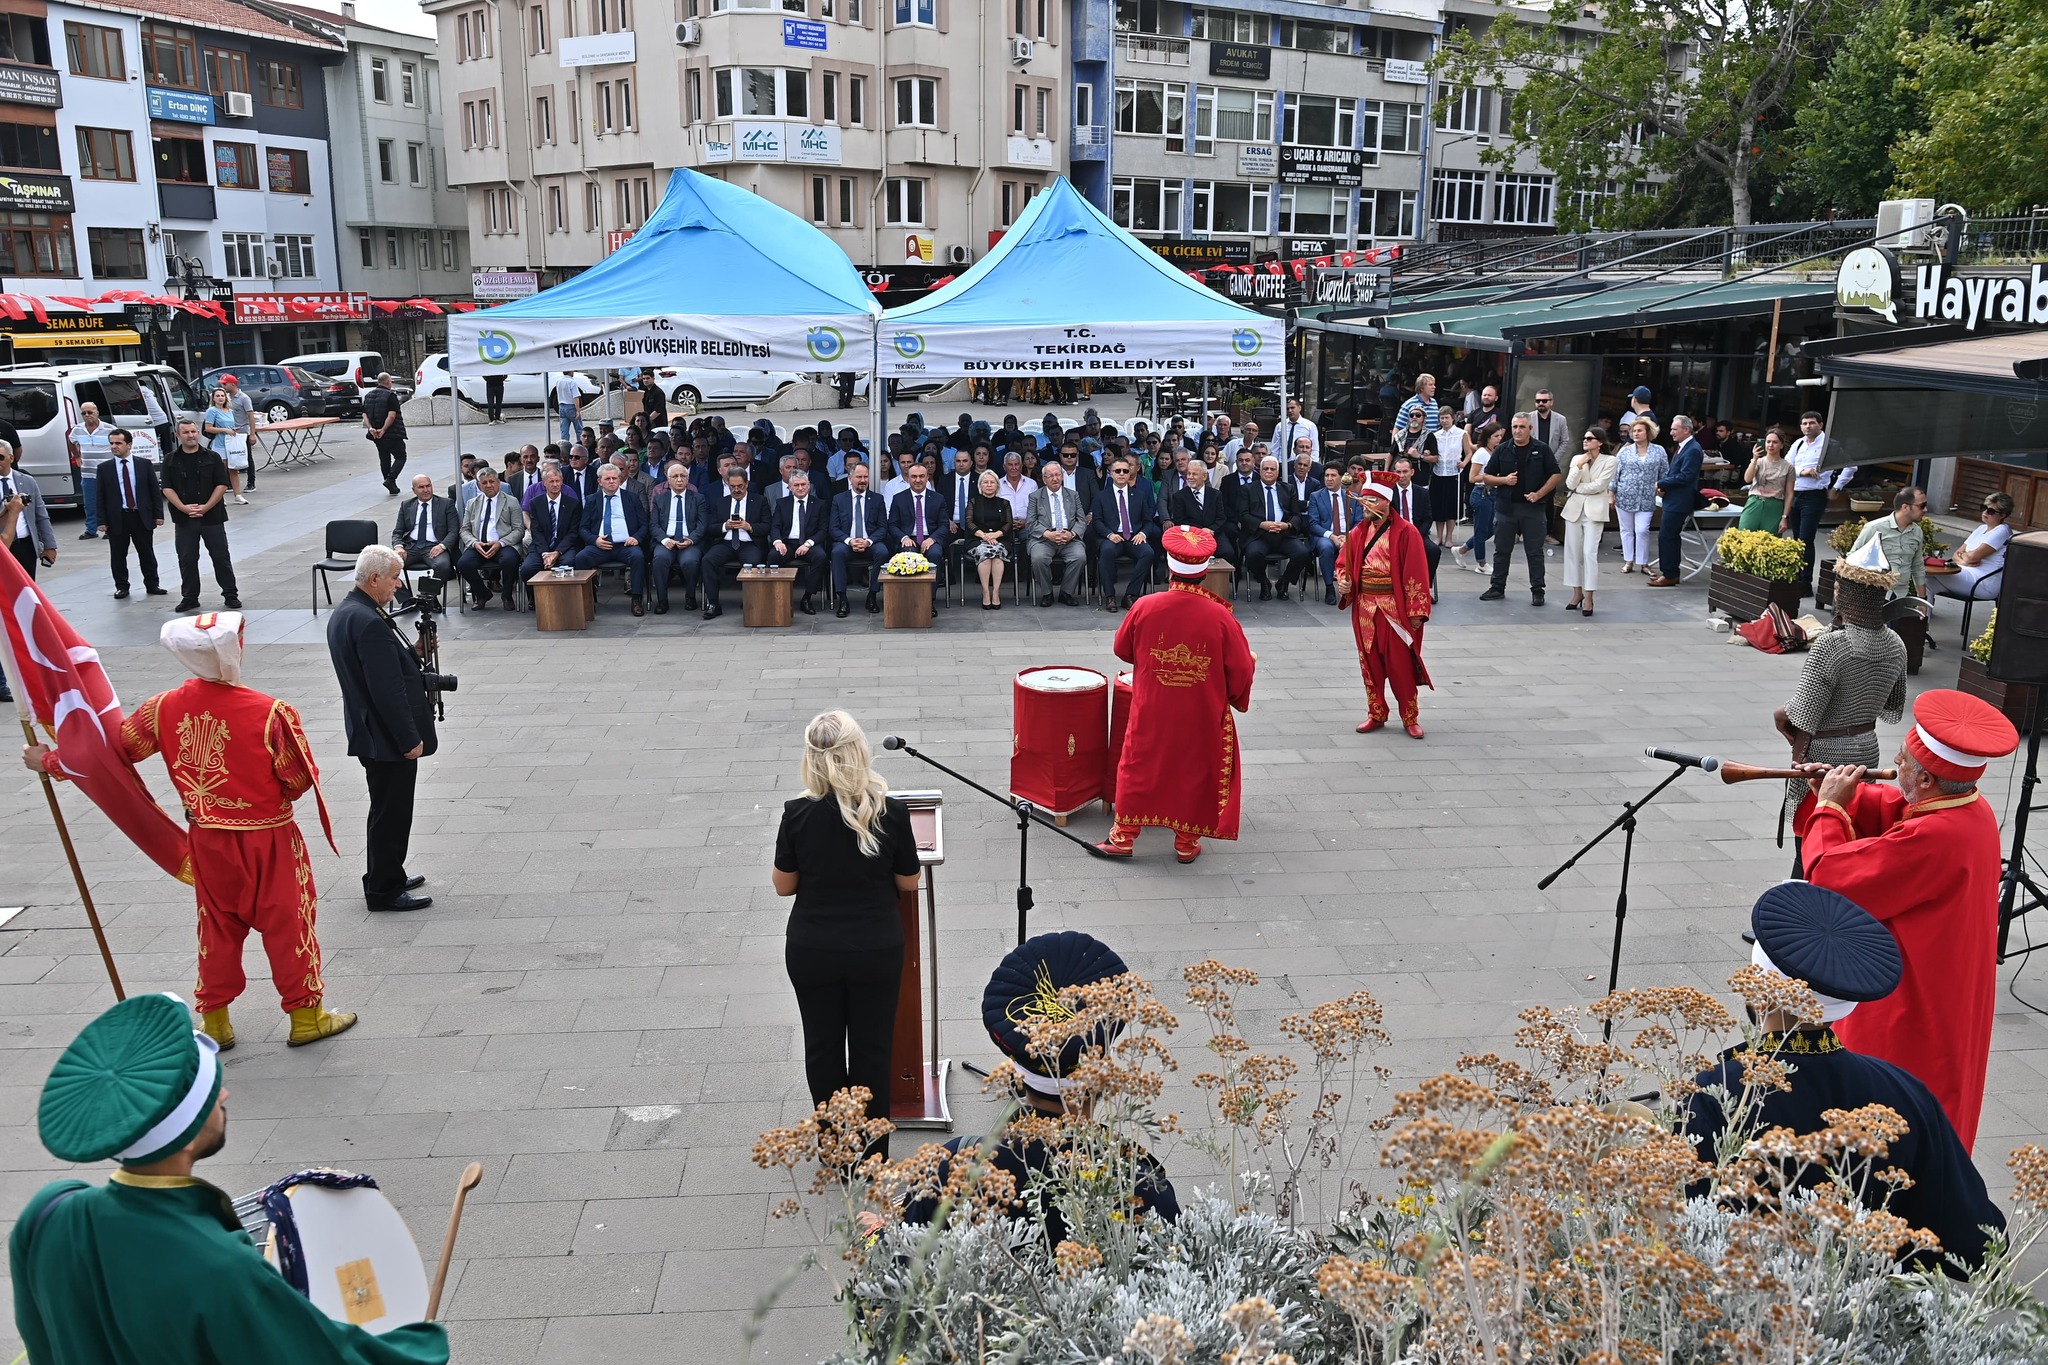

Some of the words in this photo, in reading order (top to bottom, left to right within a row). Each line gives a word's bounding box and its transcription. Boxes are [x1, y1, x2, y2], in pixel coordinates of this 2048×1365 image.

[1226, 48, 1258, 59] AVUKAT
[1219, 59, 1240, 67] ERDEM
[22, 71, 57, 87] İNŞAAT
[168, 100, 189, 111] Ertan
[743, 141, 779, 151] MHC
[801, 139, 828, 150] MHC
[216, 146, 236, 162] ARSA
[1246, 147, 1272, 156] ERSAĞ
[1293, 148, 1314, 163] UÇAR
[1315, 149, 1322, 162] &
[1323, 150, 1352, 164] ARICAN
[10, 183, 62, 199] TAŞPINAR
[1173, 244, 1203, 258] ÇİÇEK
[1206, 245, 1223, 257] EVİ
[1291, 240, 1323, 252] DETA
[510, 274, 535, 286] EMLAK
[1229, 273, 1252, 297] GANOS
[1254, 274, 1286, 299] COFFEE
[1354, 272, 1377, 287] COFFEE
[213, 285, 231, 296] ĞLU
[1316, 270, 1351, 303] Cuerda
[1356, 288, 1374, 302] SHOP
[46, 317, 75, 330] SEMA
[79, 315, 105, 329] BÜFE
[648, 318, 674, 331] T.C.
[1063, 328, 1096, 338] T.C.
[86, 337, 105, 345] BÜFE
[554, 337, 616, 359] TEKİRDAĞ
[619, 335, 698, 357] BÜYÜKŞEHİR
[701, 339, 771, 358] BELEDİYESİ
[1033, 342, 1126, 355] TEKİRDAĞ
[894, 362, 926, 370] TEKİRDAĞ
[964, 358, 1084, 373] BÜYÜKŞEHİR
[1089, 357, 1195, 371] BELEDİYESİ
